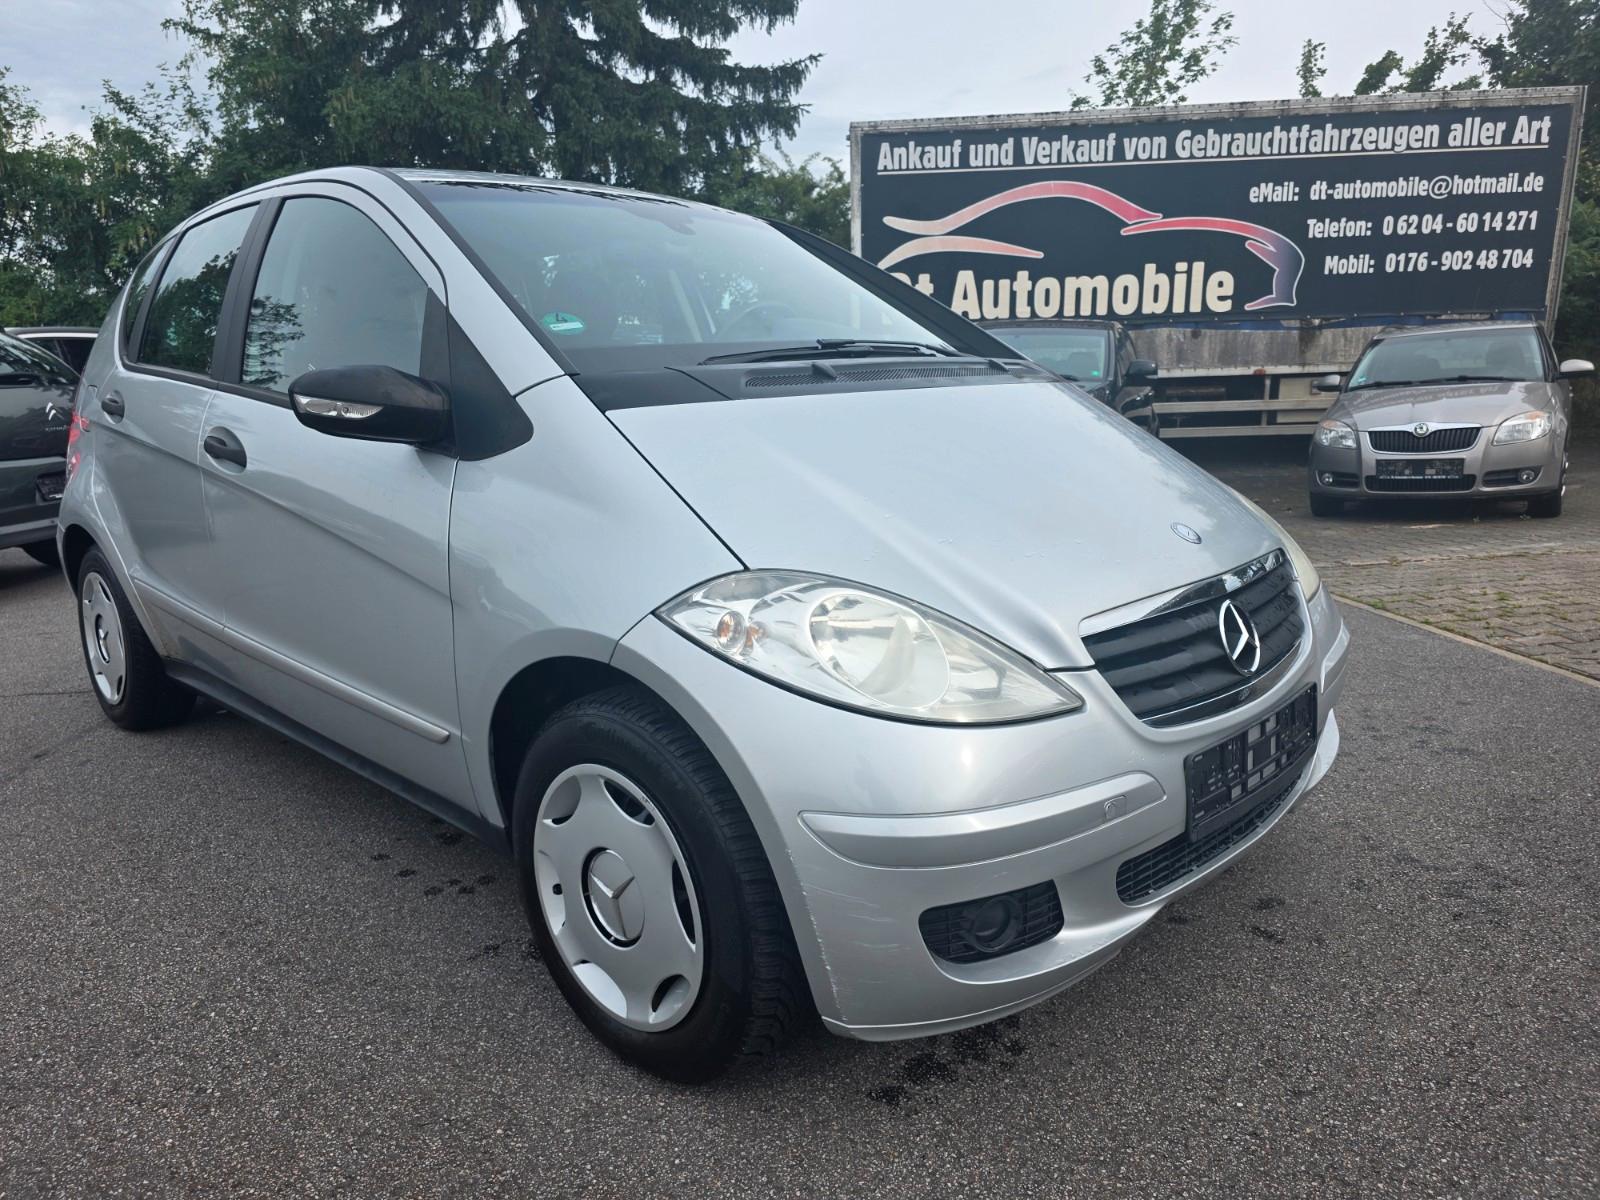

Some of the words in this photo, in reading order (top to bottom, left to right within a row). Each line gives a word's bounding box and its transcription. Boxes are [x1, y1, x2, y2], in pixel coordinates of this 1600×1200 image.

[877, 138, 962, 171] Ankauf
[968, 137, 1015, 168] und
[1021, 132, 1117, 165] Verkauf
[1122, 135, 1168, 161] von
[1174, 123, 1441, 159] Gebrauchtfahrzeugen
[1447, 116, 1507, 148] aller
[1511, 115, 1552, 145] Art
[1249, 181, 1300, 203] eMail:
[1309, 171, 1544, 201] dt-automobile@hotmail.de
[1306, 218, 1373, 239] Telefon:
[1324, 253, 1375, 275] Mobil:
[950, 261, 1235, 320] Automobile
